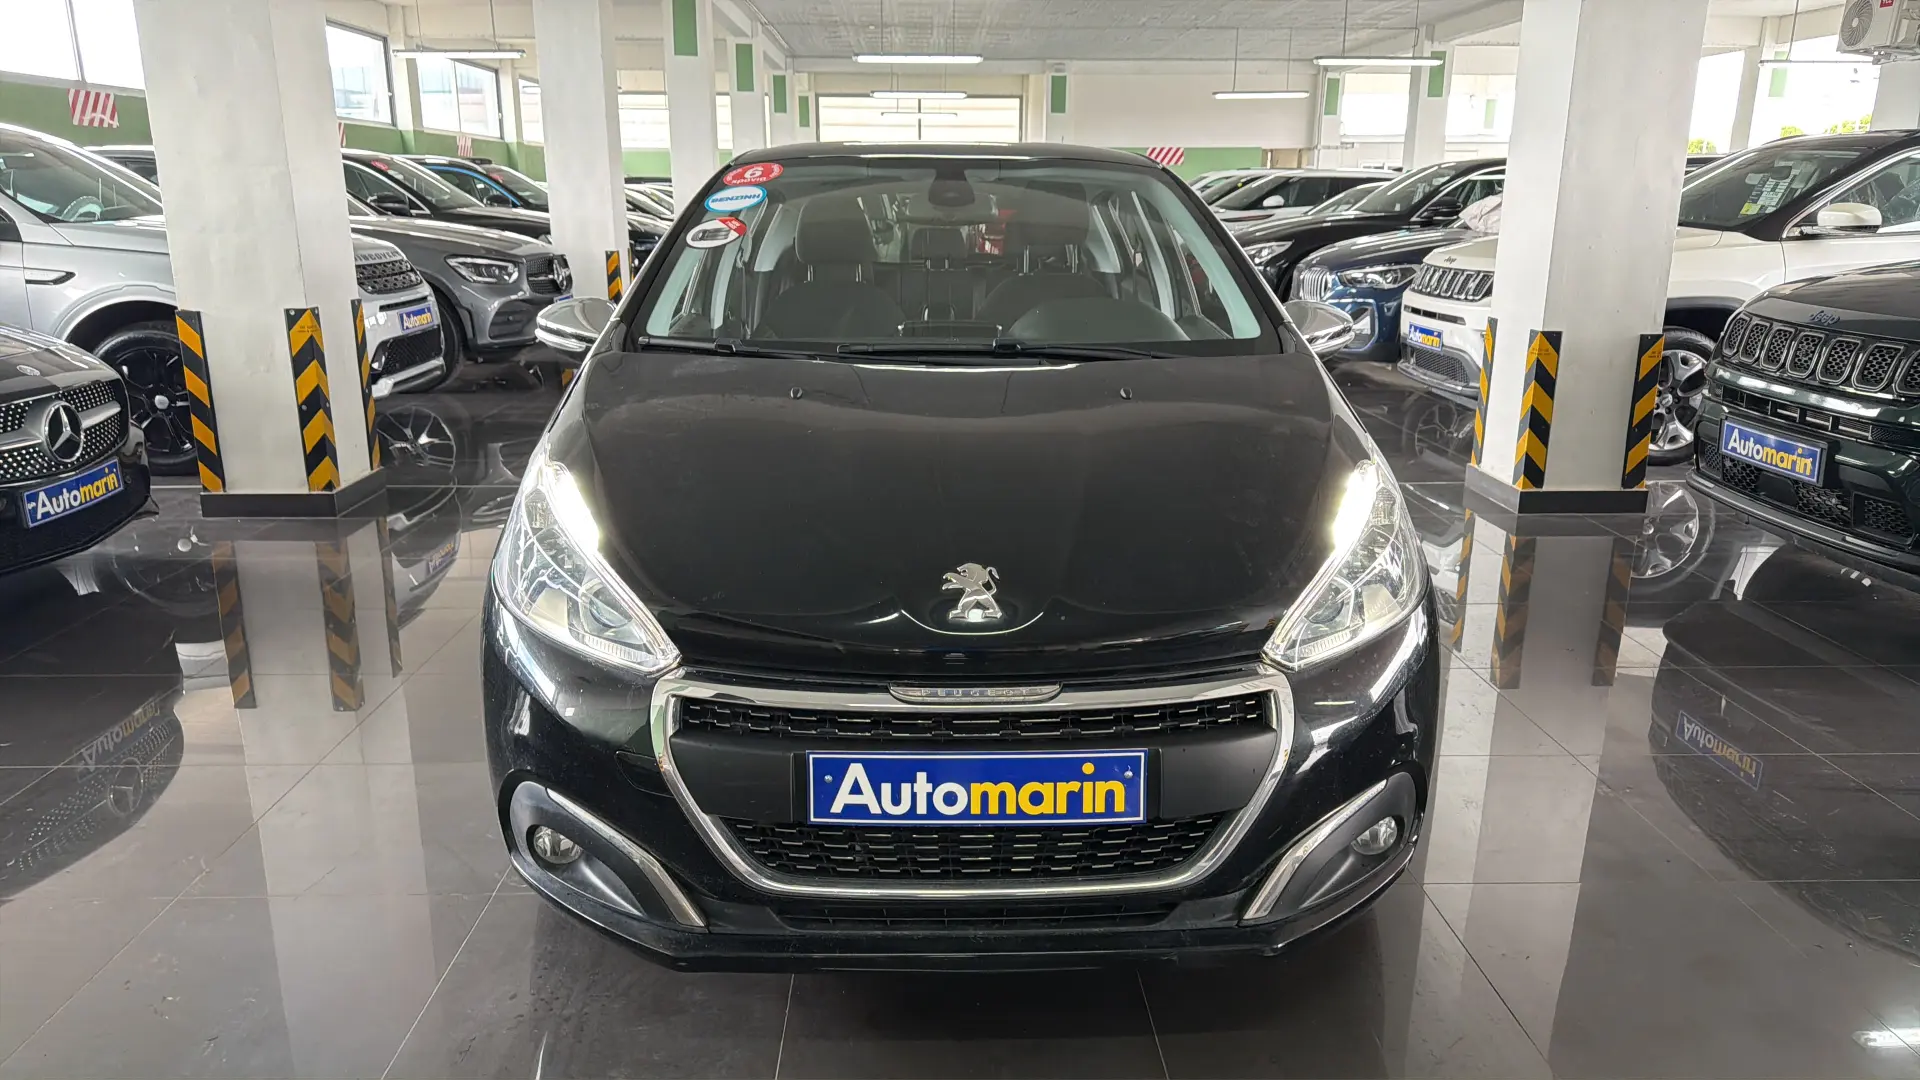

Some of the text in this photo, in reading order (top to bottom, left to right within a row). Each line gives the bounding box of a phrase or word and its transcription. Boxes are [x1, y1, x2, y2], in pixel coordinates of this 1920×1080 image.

[744, 166, 764, 179] 6
[1809, 310, 1841, 325] Jeep
[1728, 428, 1813, 476] Automarin
[37, 467, 119, 520] Automarin
[921, 688, 1030, 697] PEUGEOT
[829, 762, 1126, 816] Automarin
